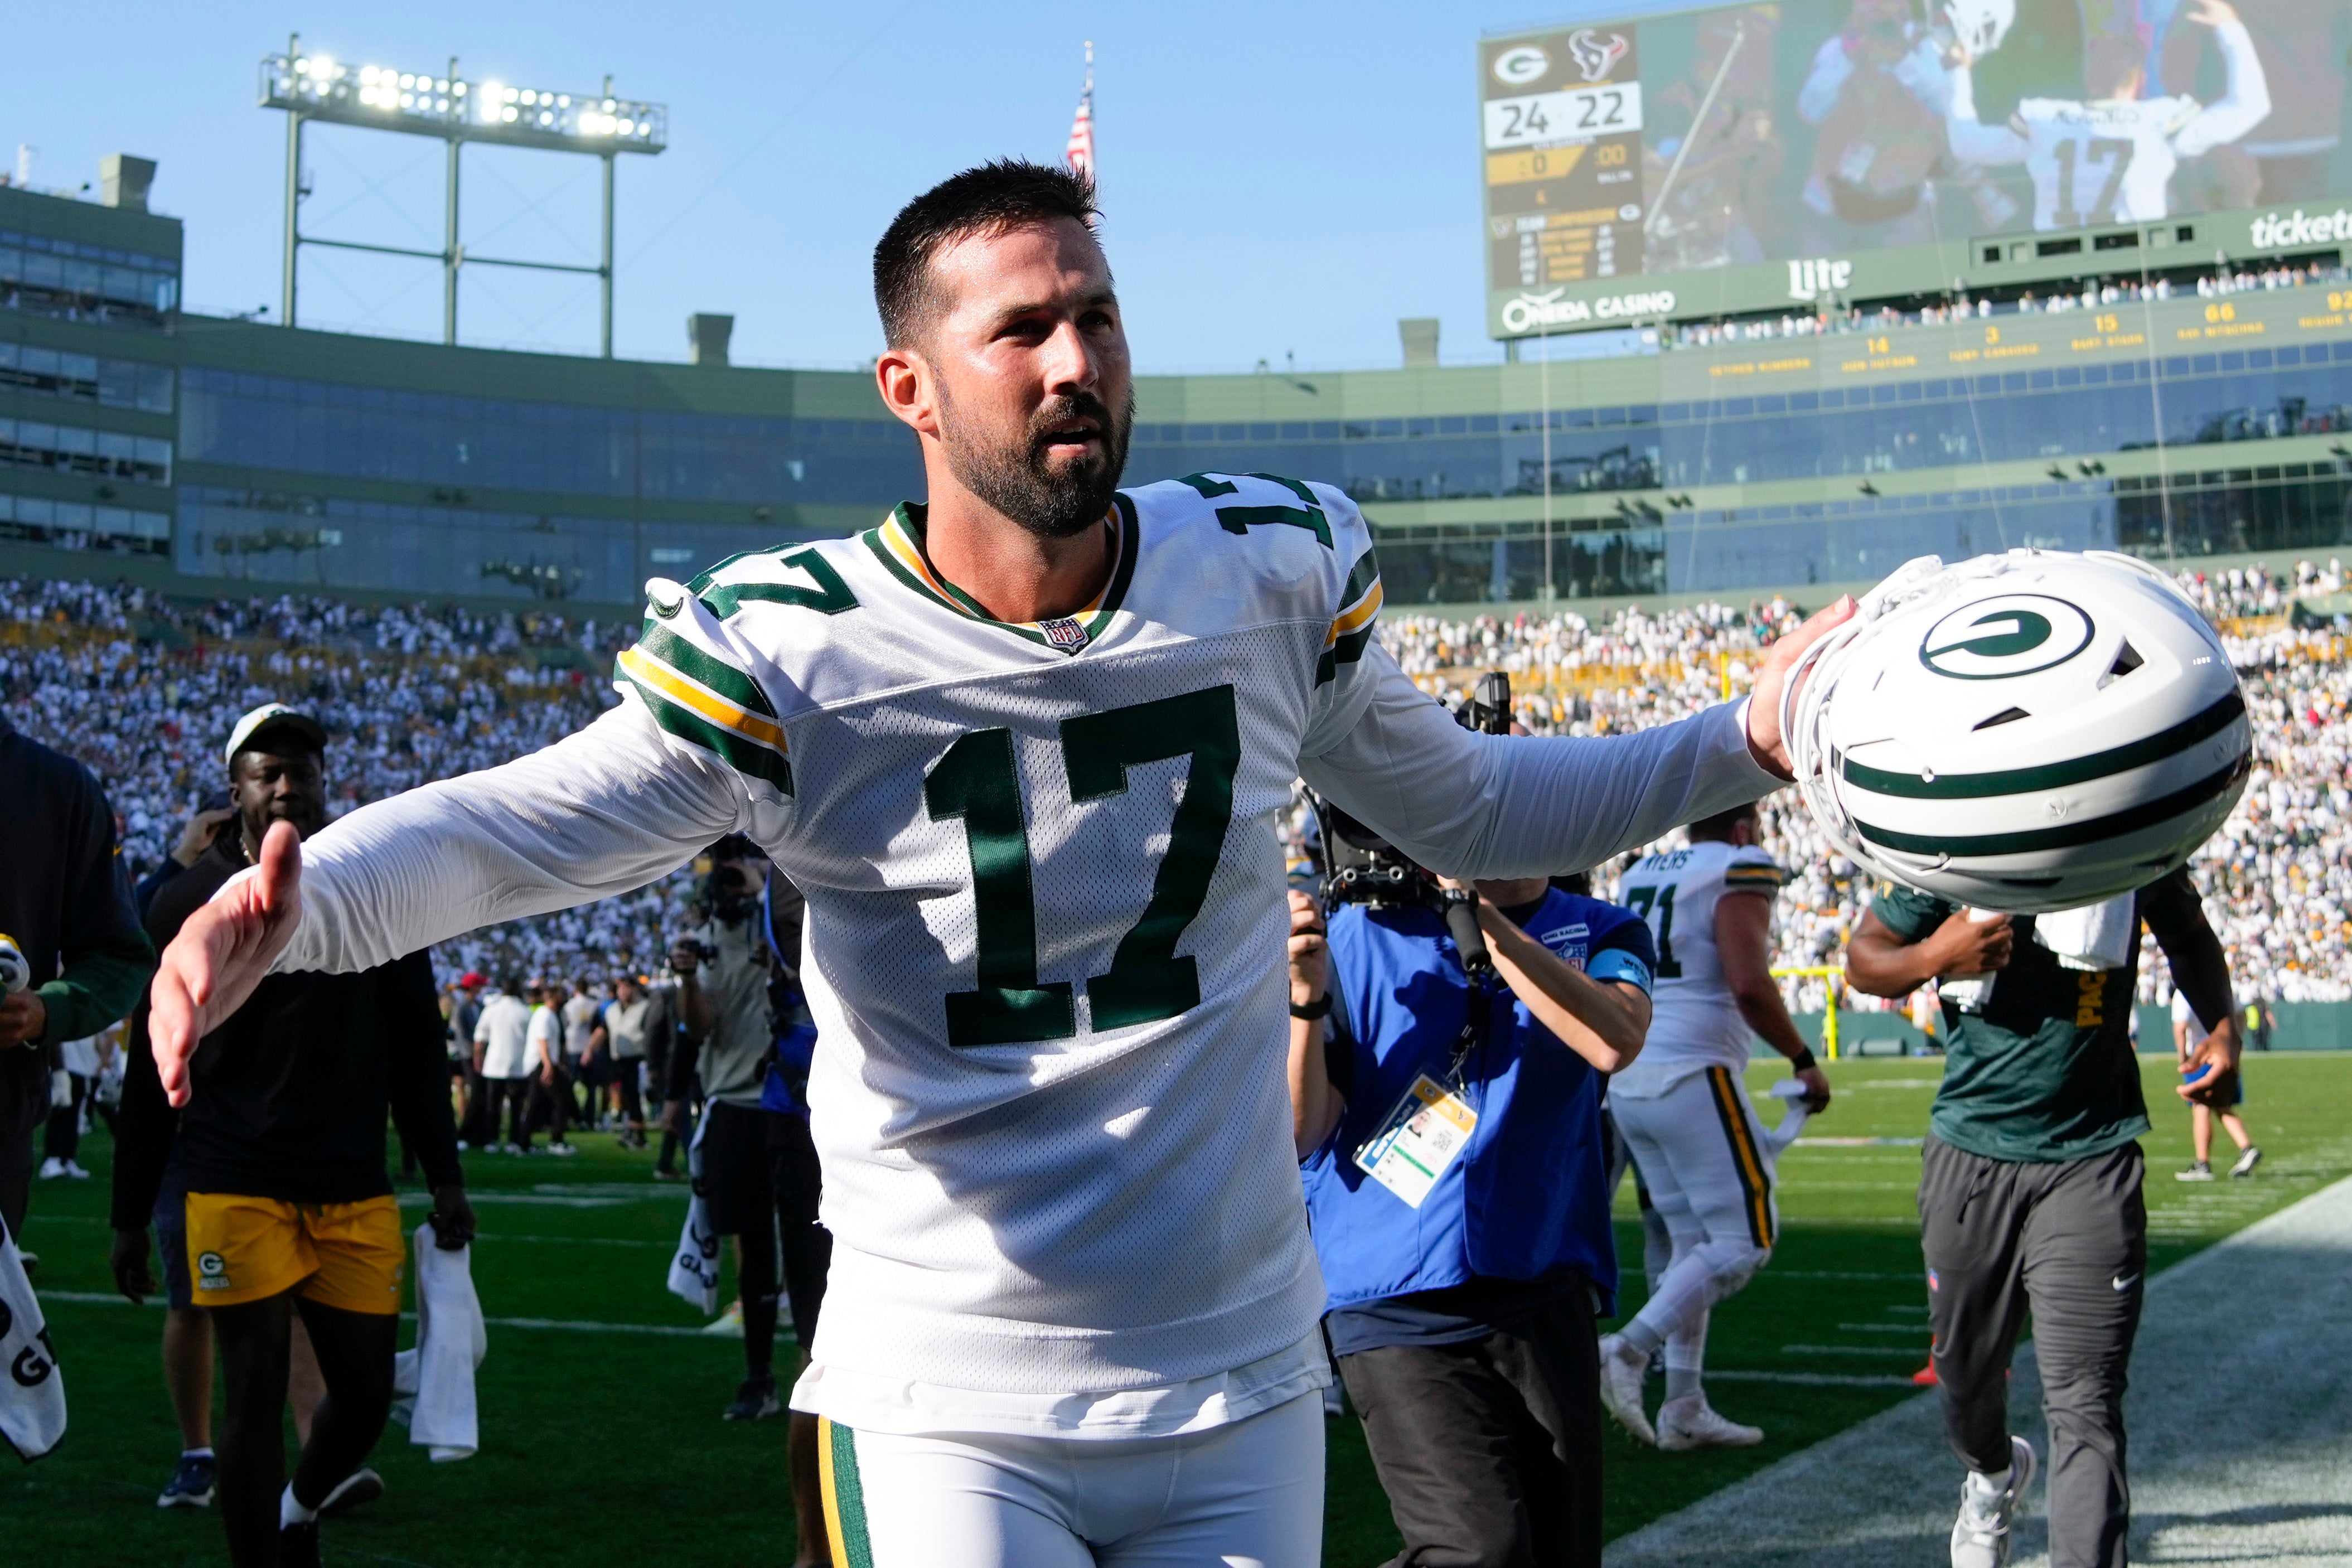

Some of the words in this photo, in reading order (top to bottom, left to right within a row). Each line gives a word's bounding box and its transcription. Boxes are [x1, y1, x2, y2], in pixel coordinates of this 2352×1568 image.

[1502, 101, 1548, 139] 24
[1577, 91, 1624, 129] 22
[2053, 138, 2135, 226] 17
[2249, 208, 2352, 249] ticket
[1787, 257, 1853, 302] Lite
[1502, 297, 1592, 333] ONEIDA
[1594, 289, 1676, 320] CASINO
[2094, 313, 2118, 333] 15
[2205, 302, 2235, 323] 66
[1867, 336, 1890, 355] 14
[1985, 326, 2000, 345] 3
[1050, 626, 1082, 642] NFL
[923, 684, 1241, 1047] 17
[1625, 883, 1682, 978] 71
